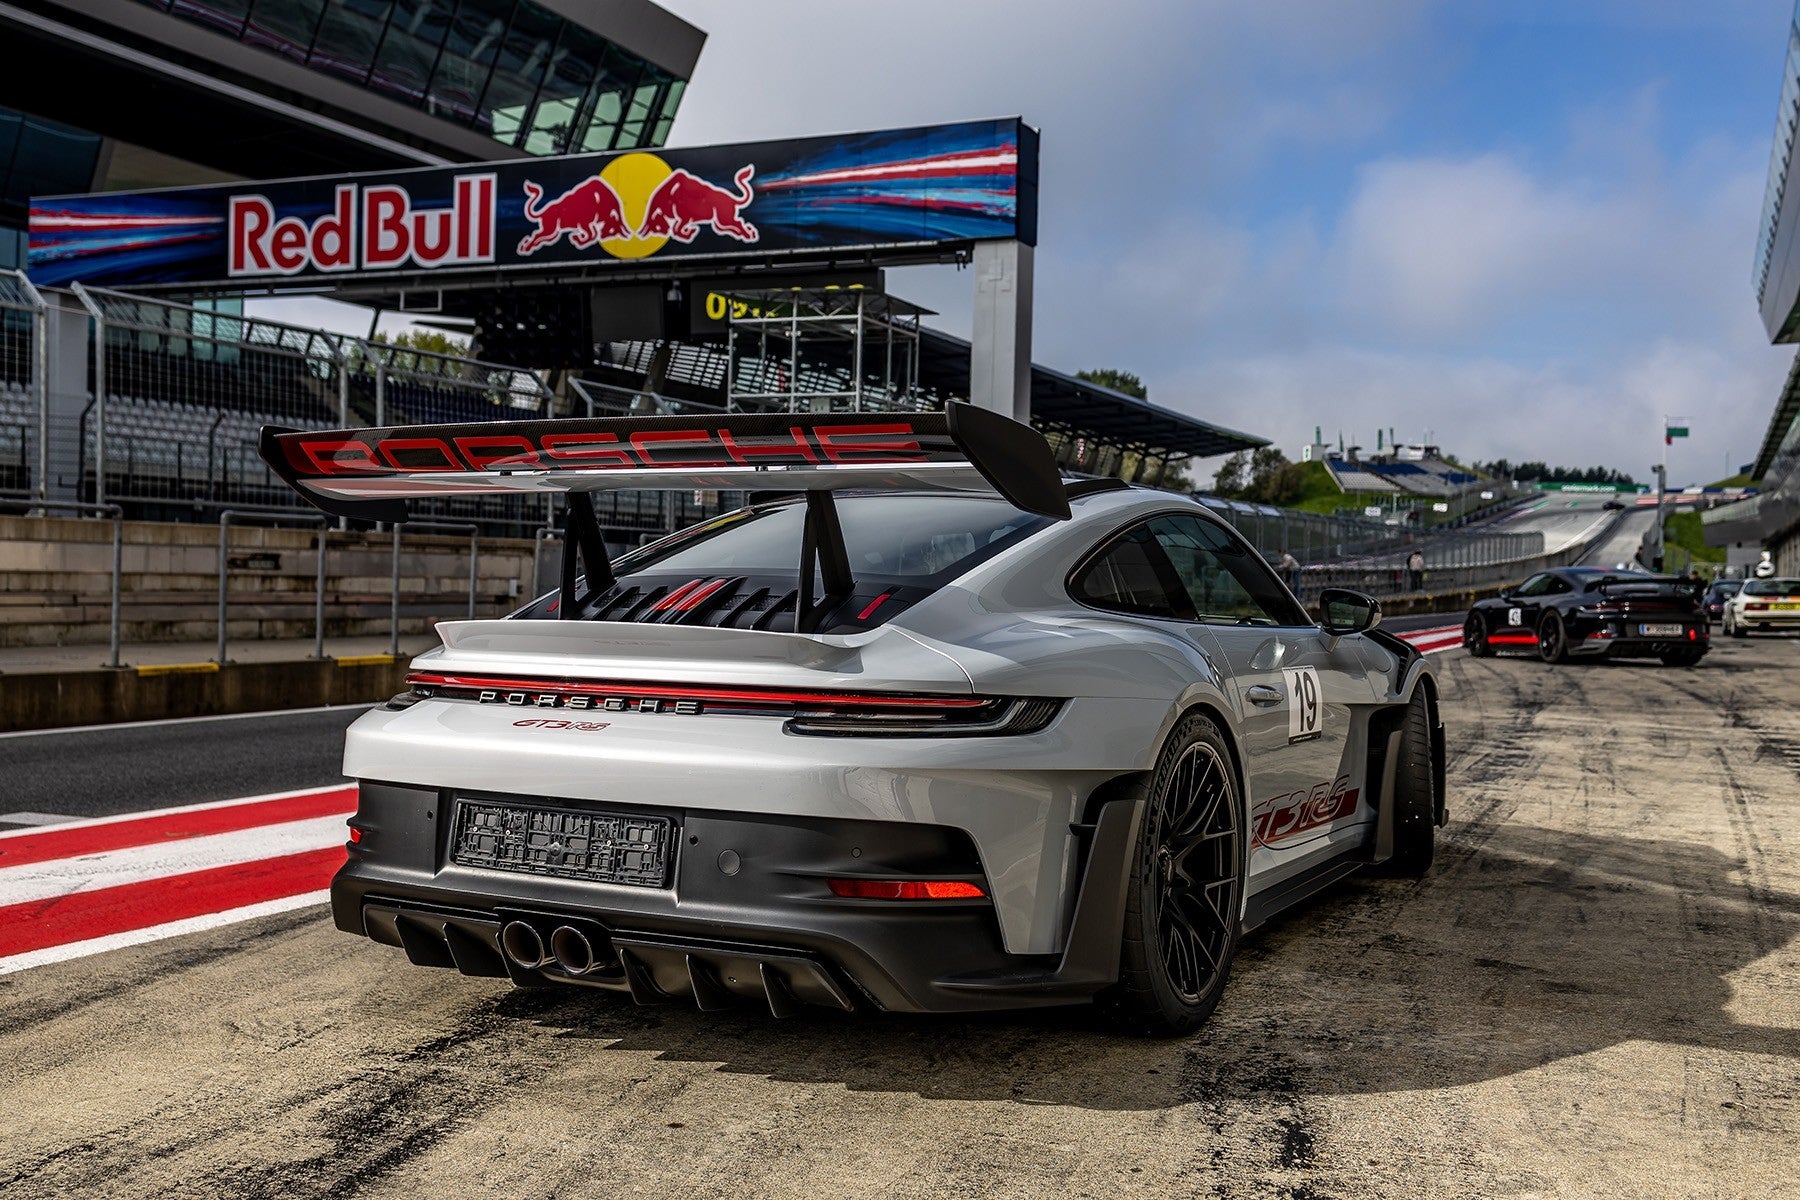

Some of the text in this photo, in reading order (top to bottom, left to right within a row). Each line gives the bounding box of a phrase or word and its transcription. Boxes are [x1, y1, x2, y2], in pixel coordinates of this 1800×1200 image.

[230, 174, 496, 276] Red Bull
[301, 423, 928, 475] PORSCHE
[478, 690, 702, 716] PORSCHE
[1294, 671, 1317, 732] 19
[1152, 733, 1182, 809] MICHELIN
